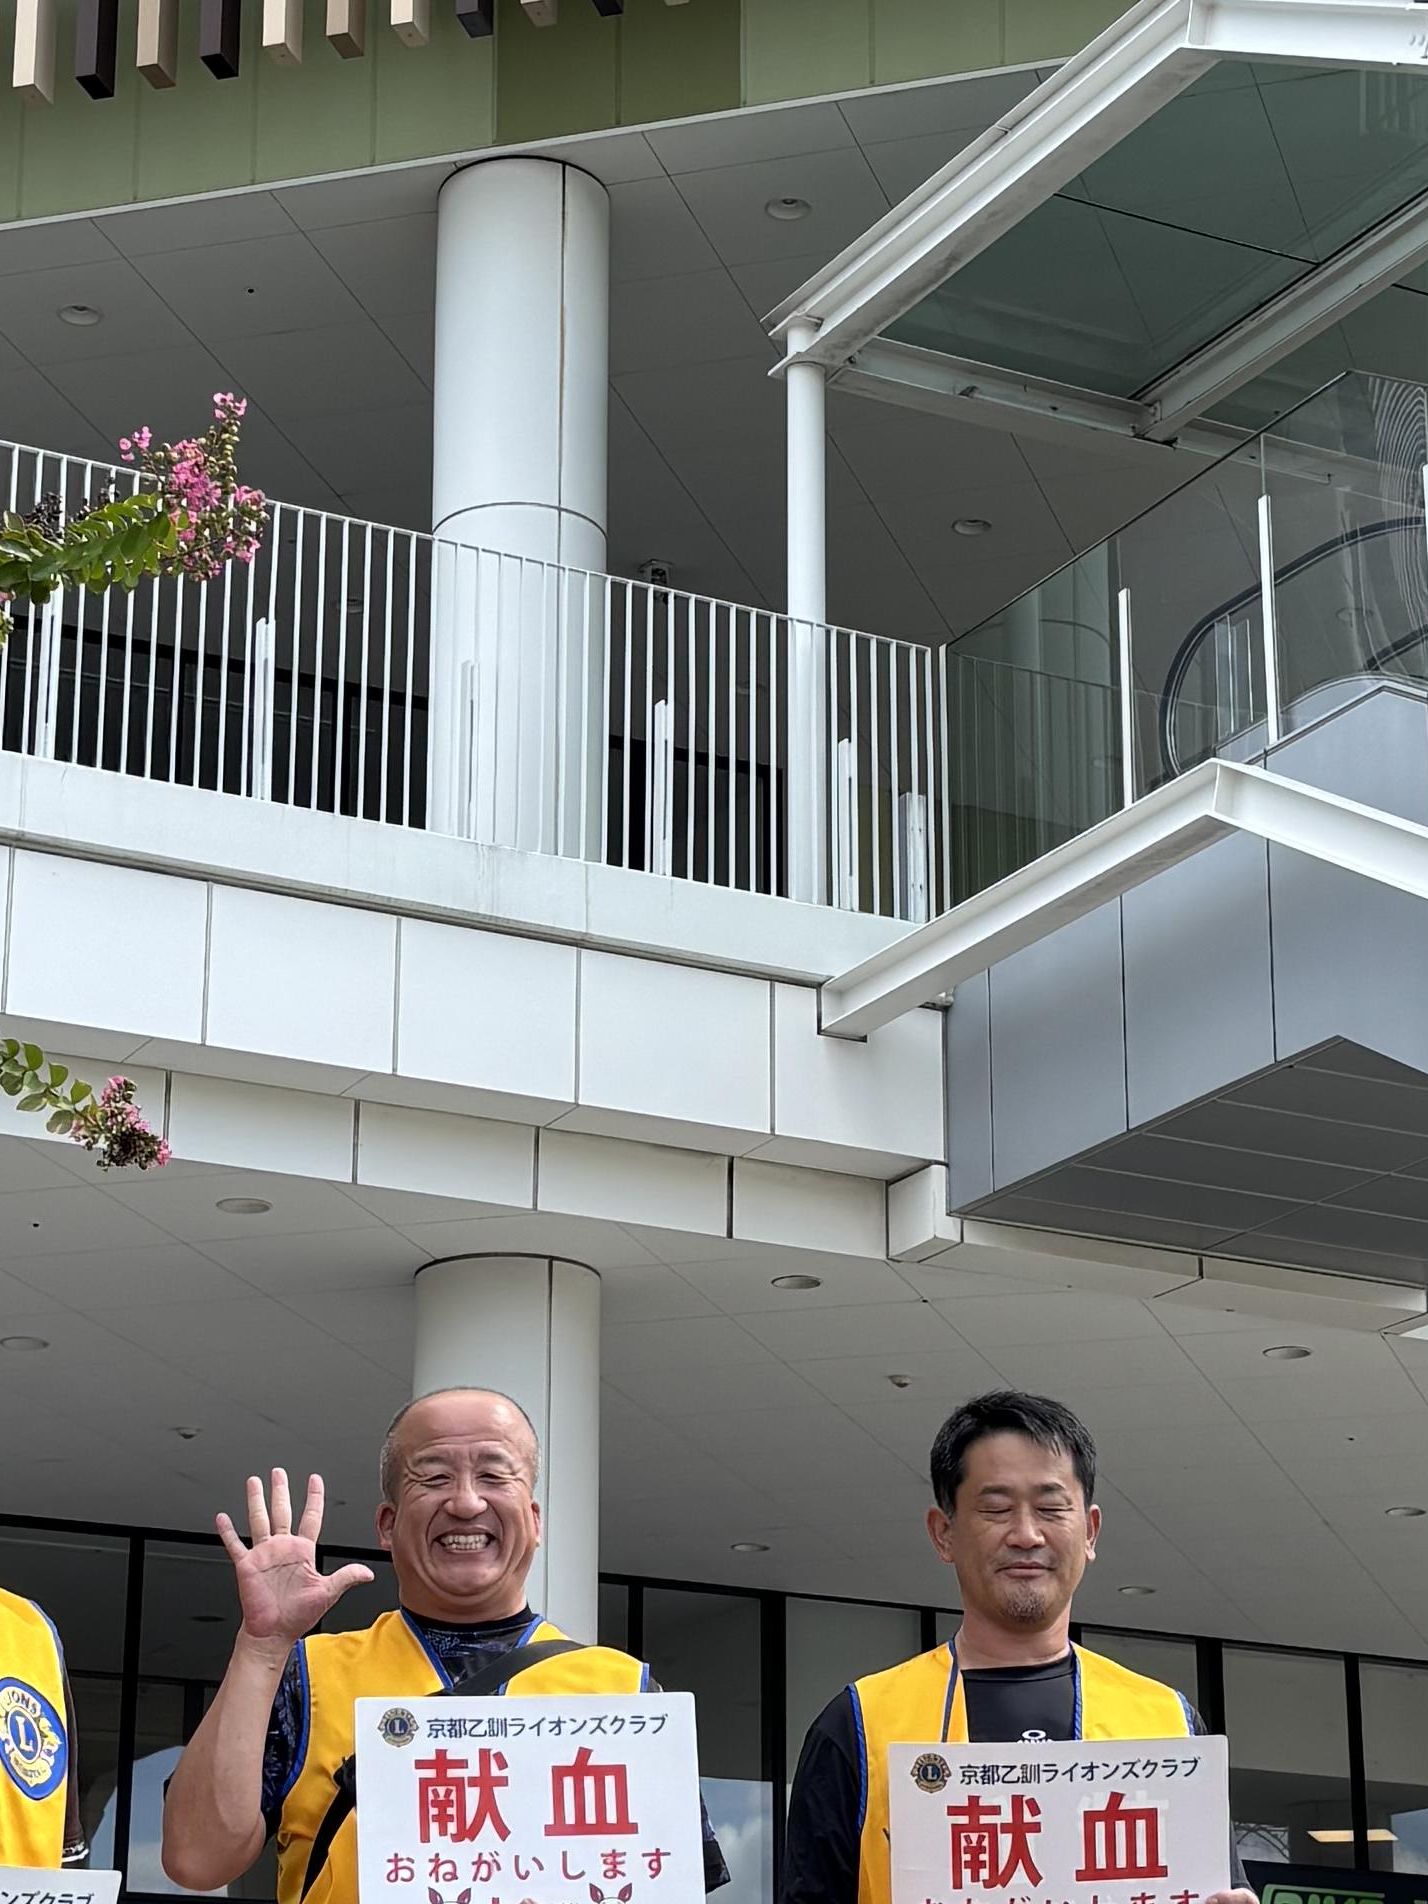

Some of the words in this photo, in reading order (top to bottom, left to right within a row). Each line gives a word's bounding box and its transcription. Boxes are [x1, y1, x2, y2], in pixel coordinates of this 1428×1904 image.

[426, 1713, 669, 1740] 京都乙訓ライオンズクラブ
[959, 1757, 1201, 1786] 京都乙訓ライオンズクラブ
[414, 1746, 639, 1844] 献血
[946, 1791, 1169, 1890] 献血
[385, 1847, 672, 1884] おねがいします
